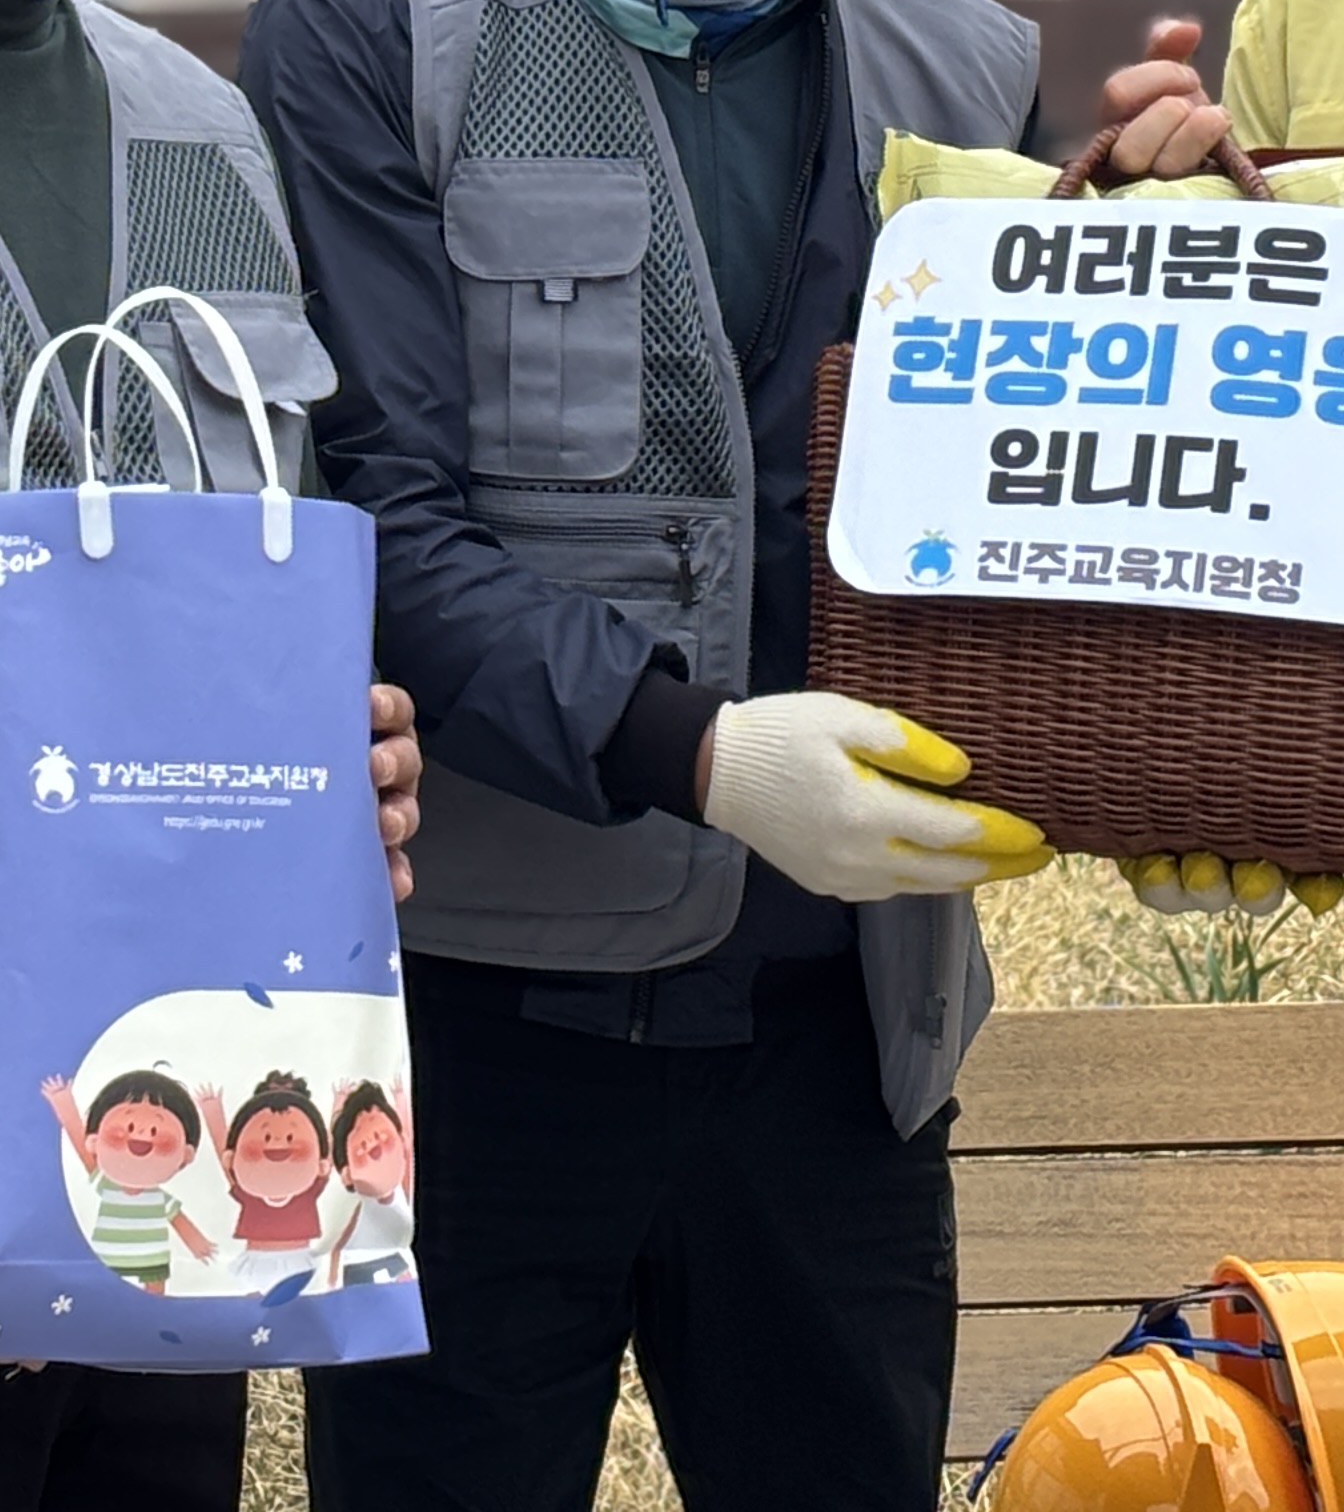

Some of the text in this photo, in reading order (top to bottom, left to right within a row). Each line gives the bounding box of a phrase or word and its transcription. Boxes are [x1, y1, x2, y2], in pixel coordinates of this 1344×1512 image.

[992, 224, 1329, 307] 여러분은
[887, 315, 1179, 407] 현장의
[987, 428, 1271, 521] 입니다.
[976, 540, 1304, 605] 진주교육지원청
[88, 761, 329, 792] 경상남도진주교육지원청
